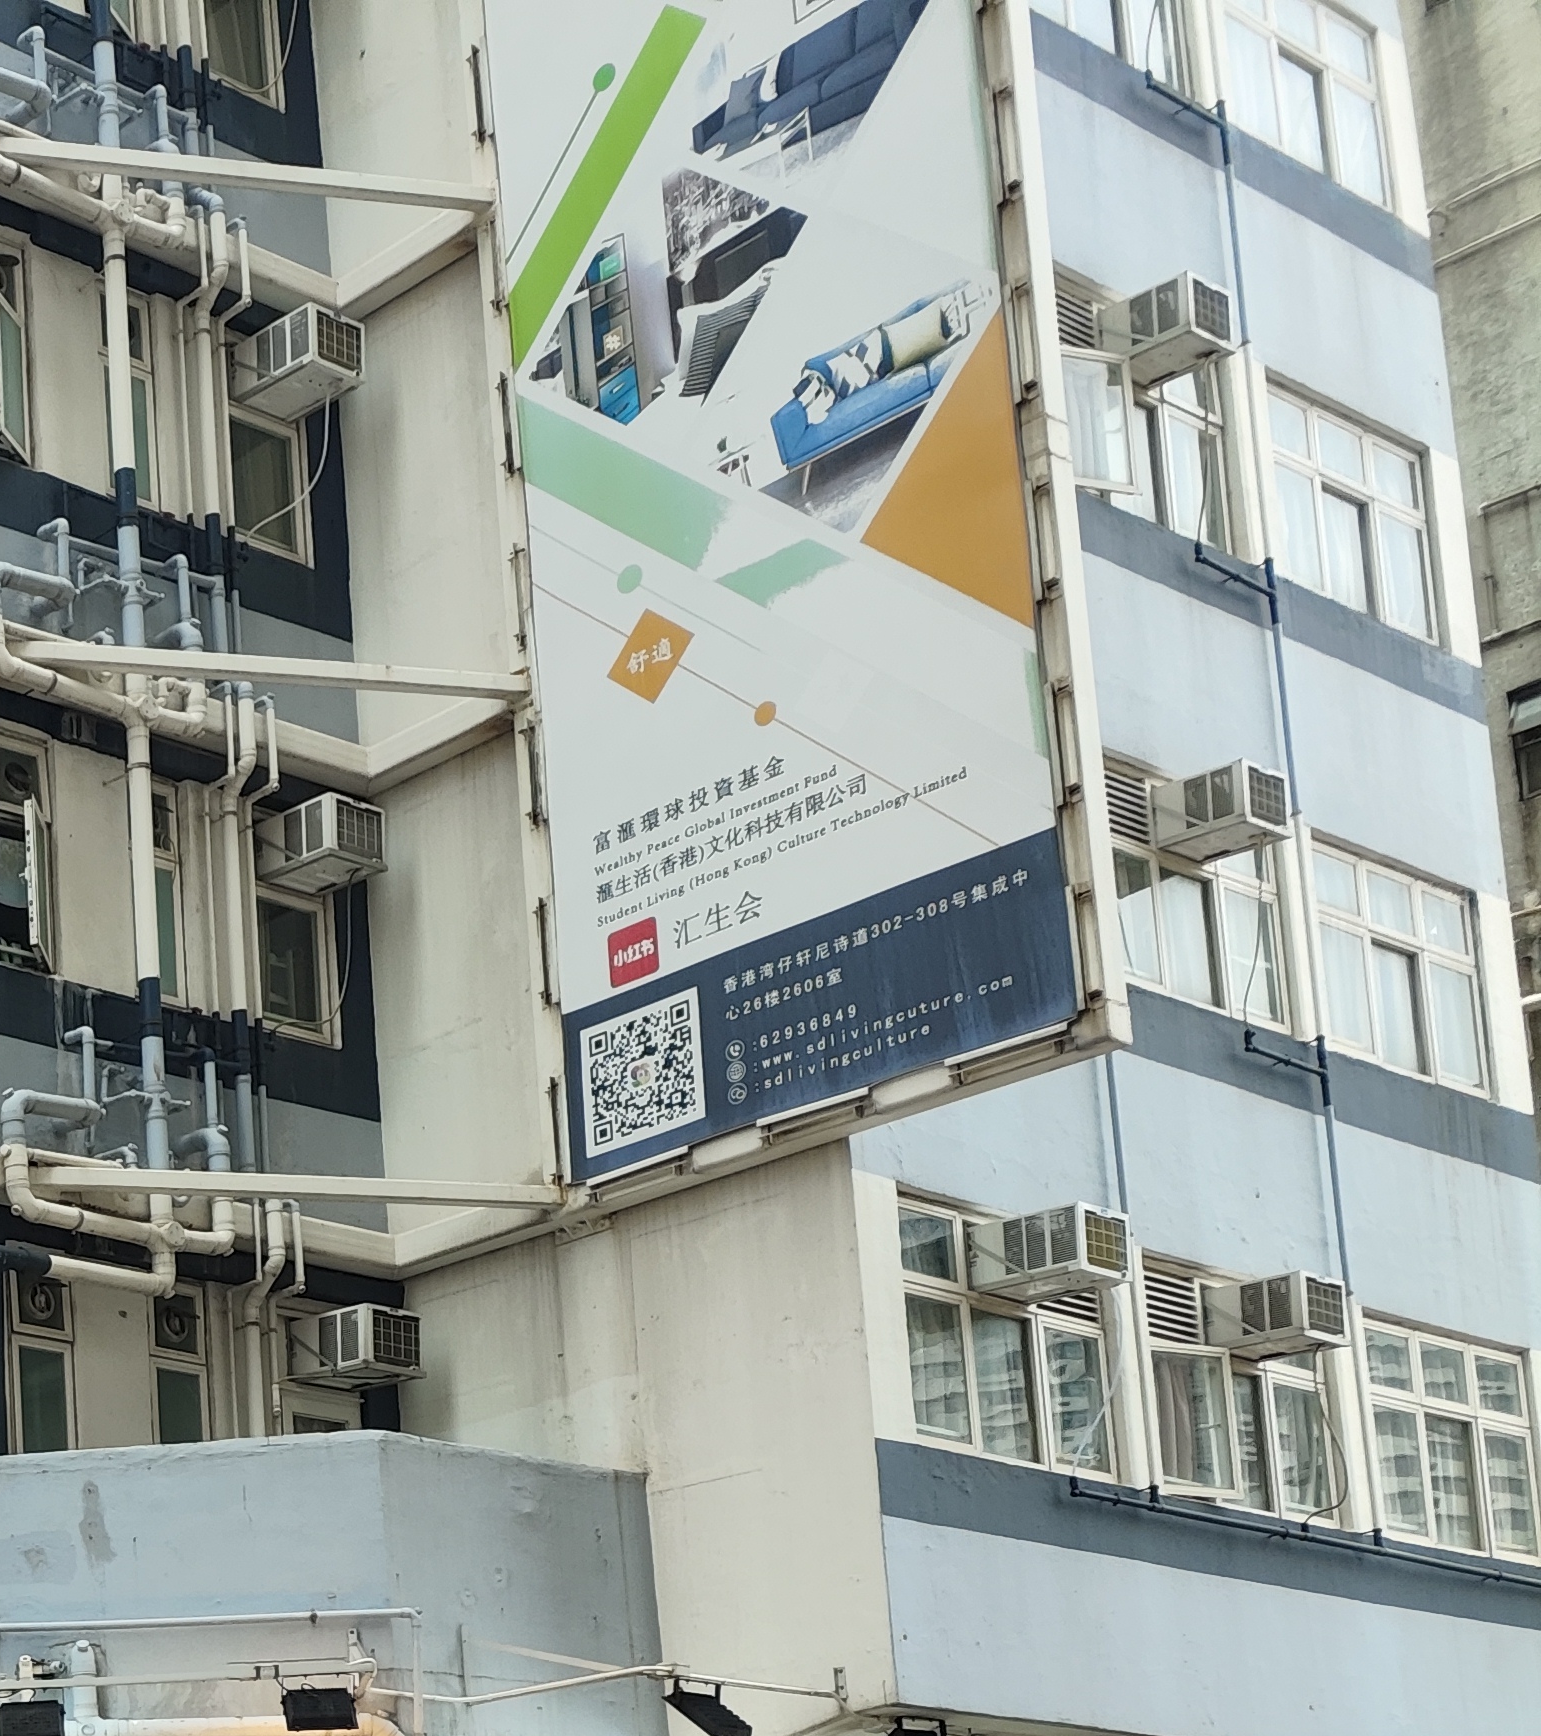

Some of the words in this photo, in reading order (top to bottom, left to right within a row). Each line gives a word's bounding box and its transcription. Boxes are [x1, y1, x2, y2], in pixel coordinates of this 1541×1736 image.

[626, 637, 675, 676] 舒適
[594, 849, 643, 878] Wealthy
[647, 833, 681, 857] Peace
[685, 812, 726, 839] Global
[729, 782, 801, 819] Investment
[804, 764, 839, 790] Fund
[597, 899, 644, 928] Student
[646, 883, 686, 911] Living
[689, 862, 730, 893] (Hong
[733, 845, 774, 874] Kong)
[777, 825, 827, 854] Culture
[830, 791, 911, 832] Technology
[914, 766, 969, 799] Limited
[674, 890, 763, 950] 汇生会
[613, 936, 655, 968] 小红书
